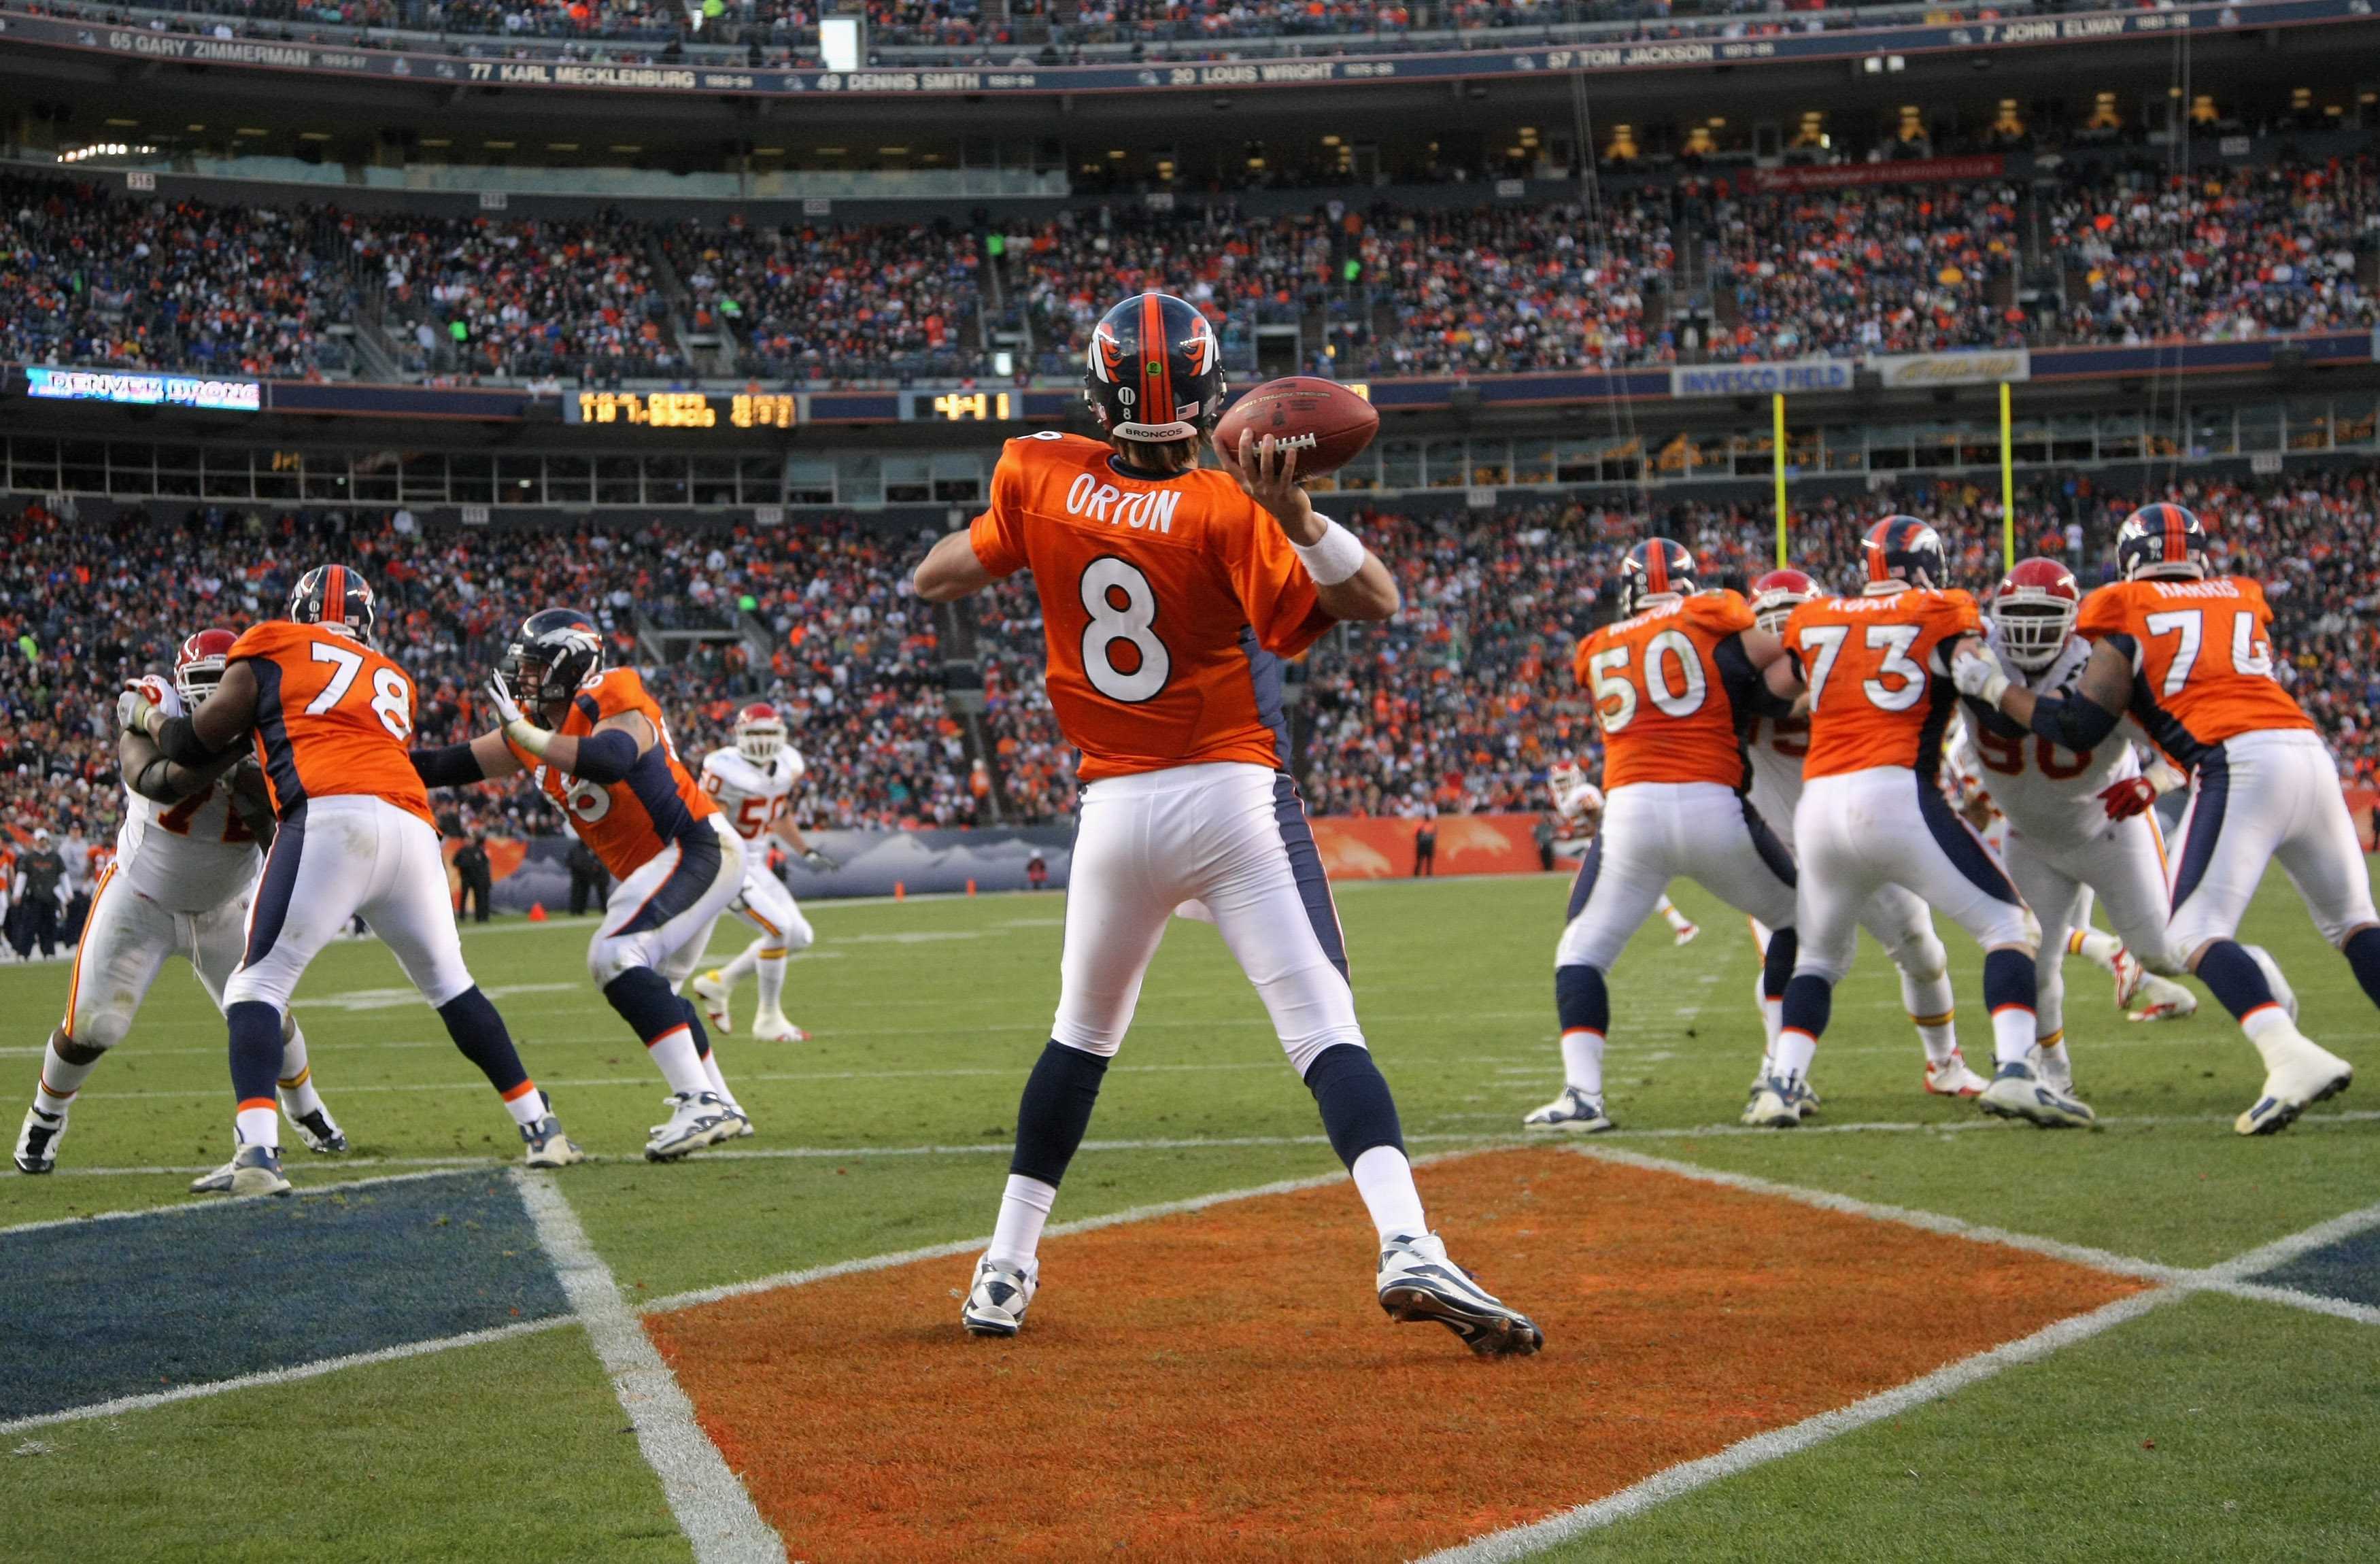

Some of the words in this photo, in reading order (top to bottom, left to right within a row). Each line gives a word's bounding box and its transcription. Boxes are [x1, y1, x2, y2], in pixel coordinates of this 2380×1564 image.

[1983, 26, 1994, 43] 7
[2001, 20, 2056, 43] JOHN
[2063, 17, 2125, 39] ELWAY
[110, 32, 131, 51] 65
[137, 34, 188, 58] GARY
[193, 41, 310, 67] ZIMMERMAN
[1580, 48, 1620, 67] TOM
[1625, 44, 1714, 66] JACKSON
[469, 63, 493, 81] 77
[500, 65, 550, 83] KARL
[555, 67, 696, 89] MECKLENBURG
[817, 73, 841, 90] 49
[847, 73, 918, 90] DENNIS
[922, 72, 980, 90] SMITH
[1170, 68, 1195, 85] 20
[1202, 66, 1257, 84] LOUIS
[1261, 62, 1336, 83] WRIGHT
[1683, 368, 1779, 393] INVESCO
[1785, 364, 1846, 390] FIELD
[1123, 407, 1132, 420] 8
[1125, 428, 1183, 437] BRONCOS
[1066, 473, 1182, 534] ORTON
[2152, 579, 2240, 599] HARRIS
[309, 613, 319, 622] 78
[1079, 554, 1172, 704] 8
[1588, 629, 1706, 734] 50
[1799, 624, 1926, 713] 73
[304, 641, 412, 742] 78
